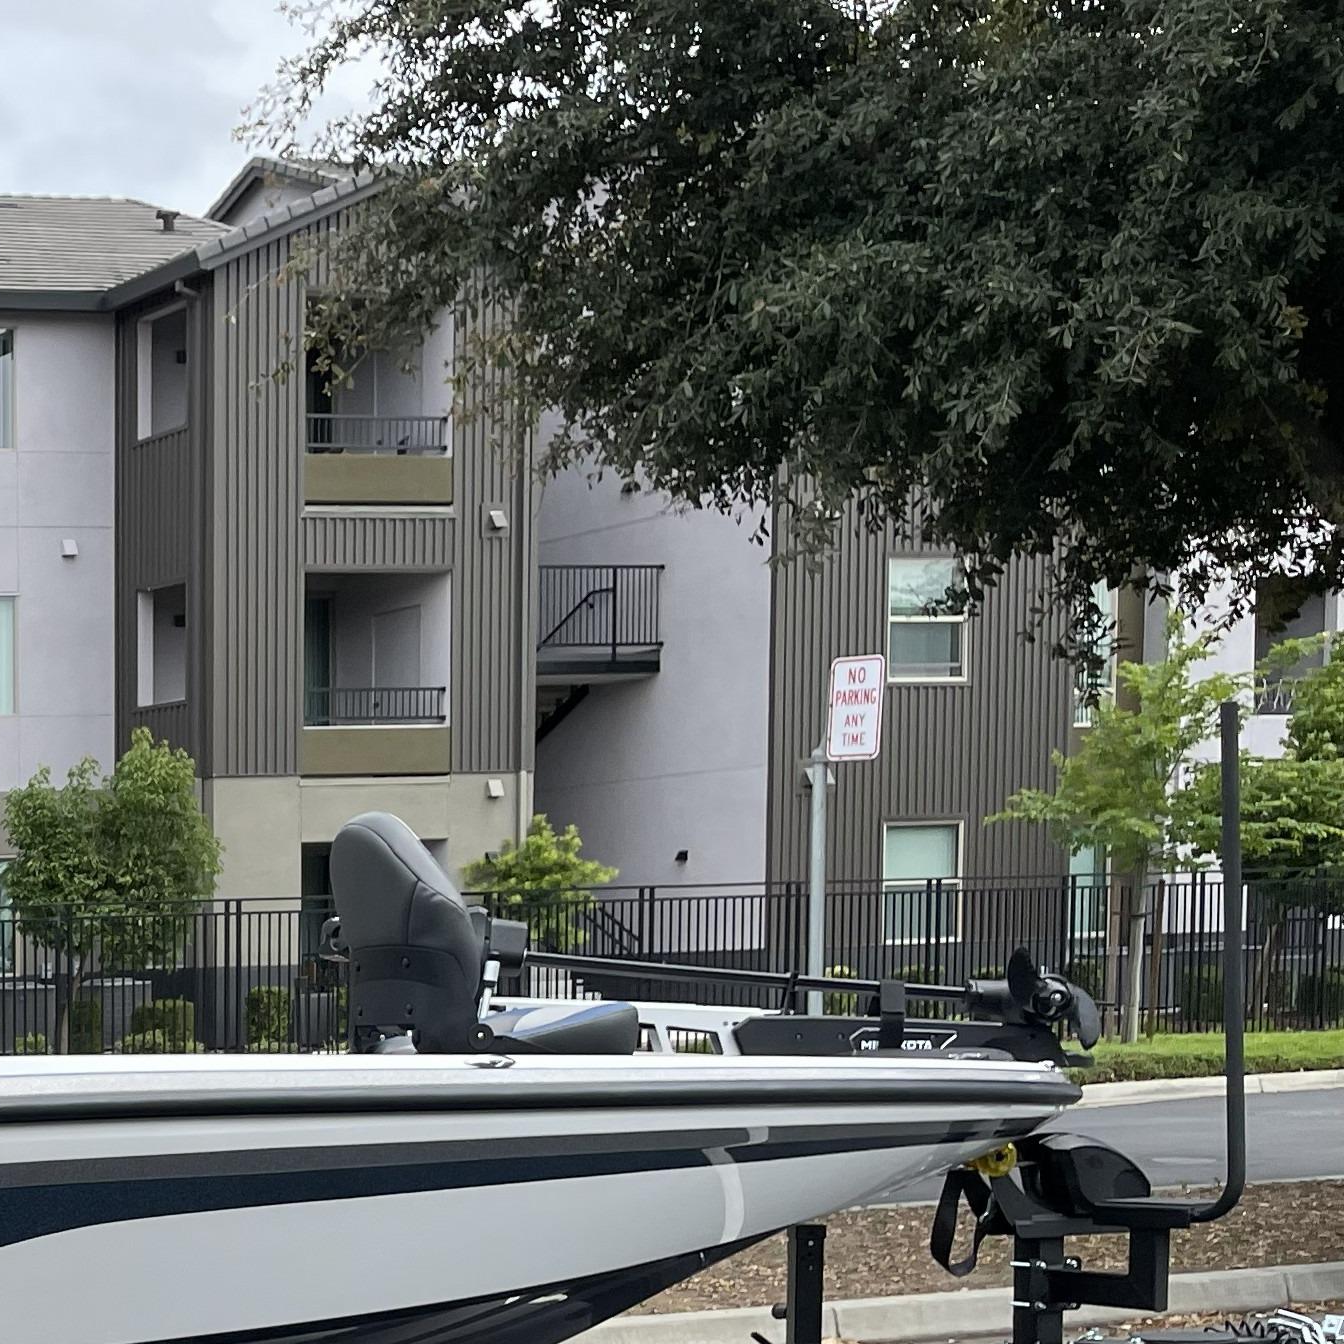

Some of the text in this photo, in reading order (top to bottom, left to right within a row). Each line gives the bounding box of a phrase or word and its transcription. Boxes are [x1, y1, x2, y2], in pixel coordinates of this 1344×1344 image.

[848, 667, 866, 685] NO
[835, 687, 876, 706] PARKING
[844, 713, 865, 728] ANY
[841, 732, 866, 746] TIME
